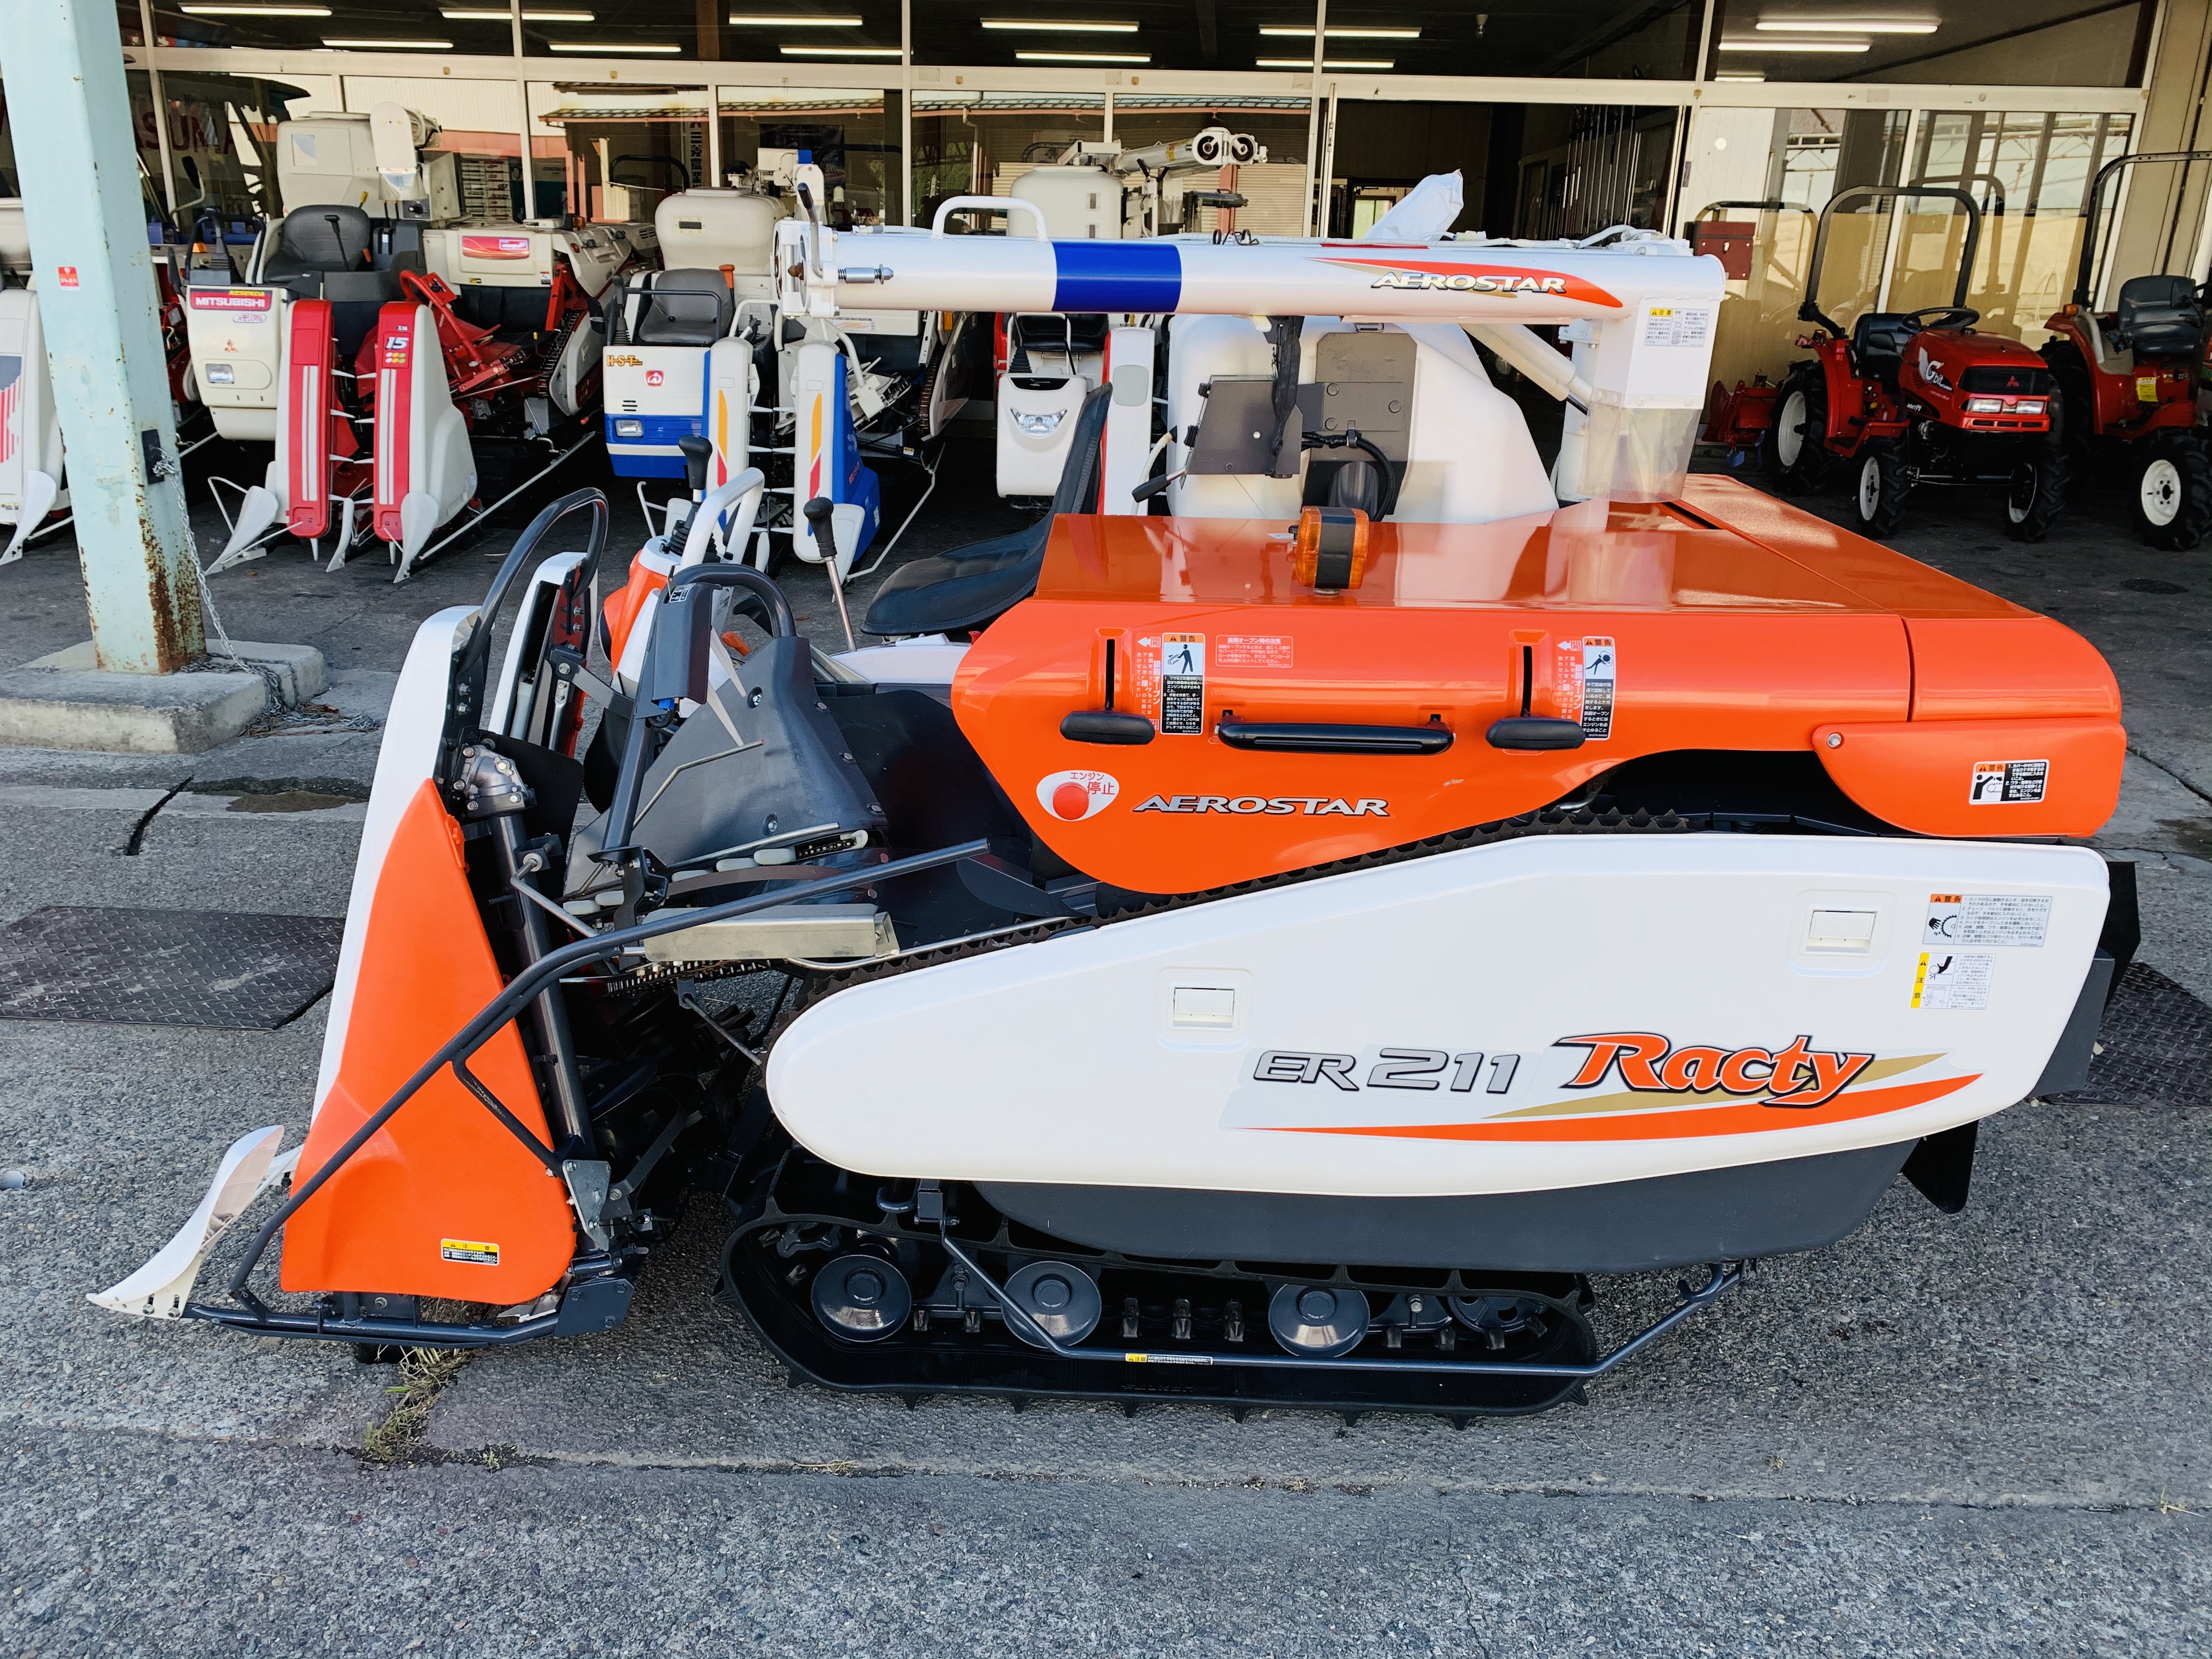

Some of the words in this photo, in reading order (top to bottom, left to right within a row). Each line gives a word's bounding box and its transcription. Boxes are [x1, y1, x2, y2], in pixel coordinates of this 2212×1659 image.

[1371, 272, 1566, 293] AEROSTAR
[195, 297, 265, 307] MITSUBISHI
[385, 336, 409, 349] 15
[1153, 661, 1161, 704] 扱胴オープン
[1573, 664, 1583, 709] 扱胴オープン
[1087, 781, 1115, 794] 停止
[1132, 794, 1390, 816] AEROSTAR
[1254, 1050, 1359, 1092] ER
[1367, 1047, 1520, 1094] 211
[1553, 1031, 1875, 1108] Racty
